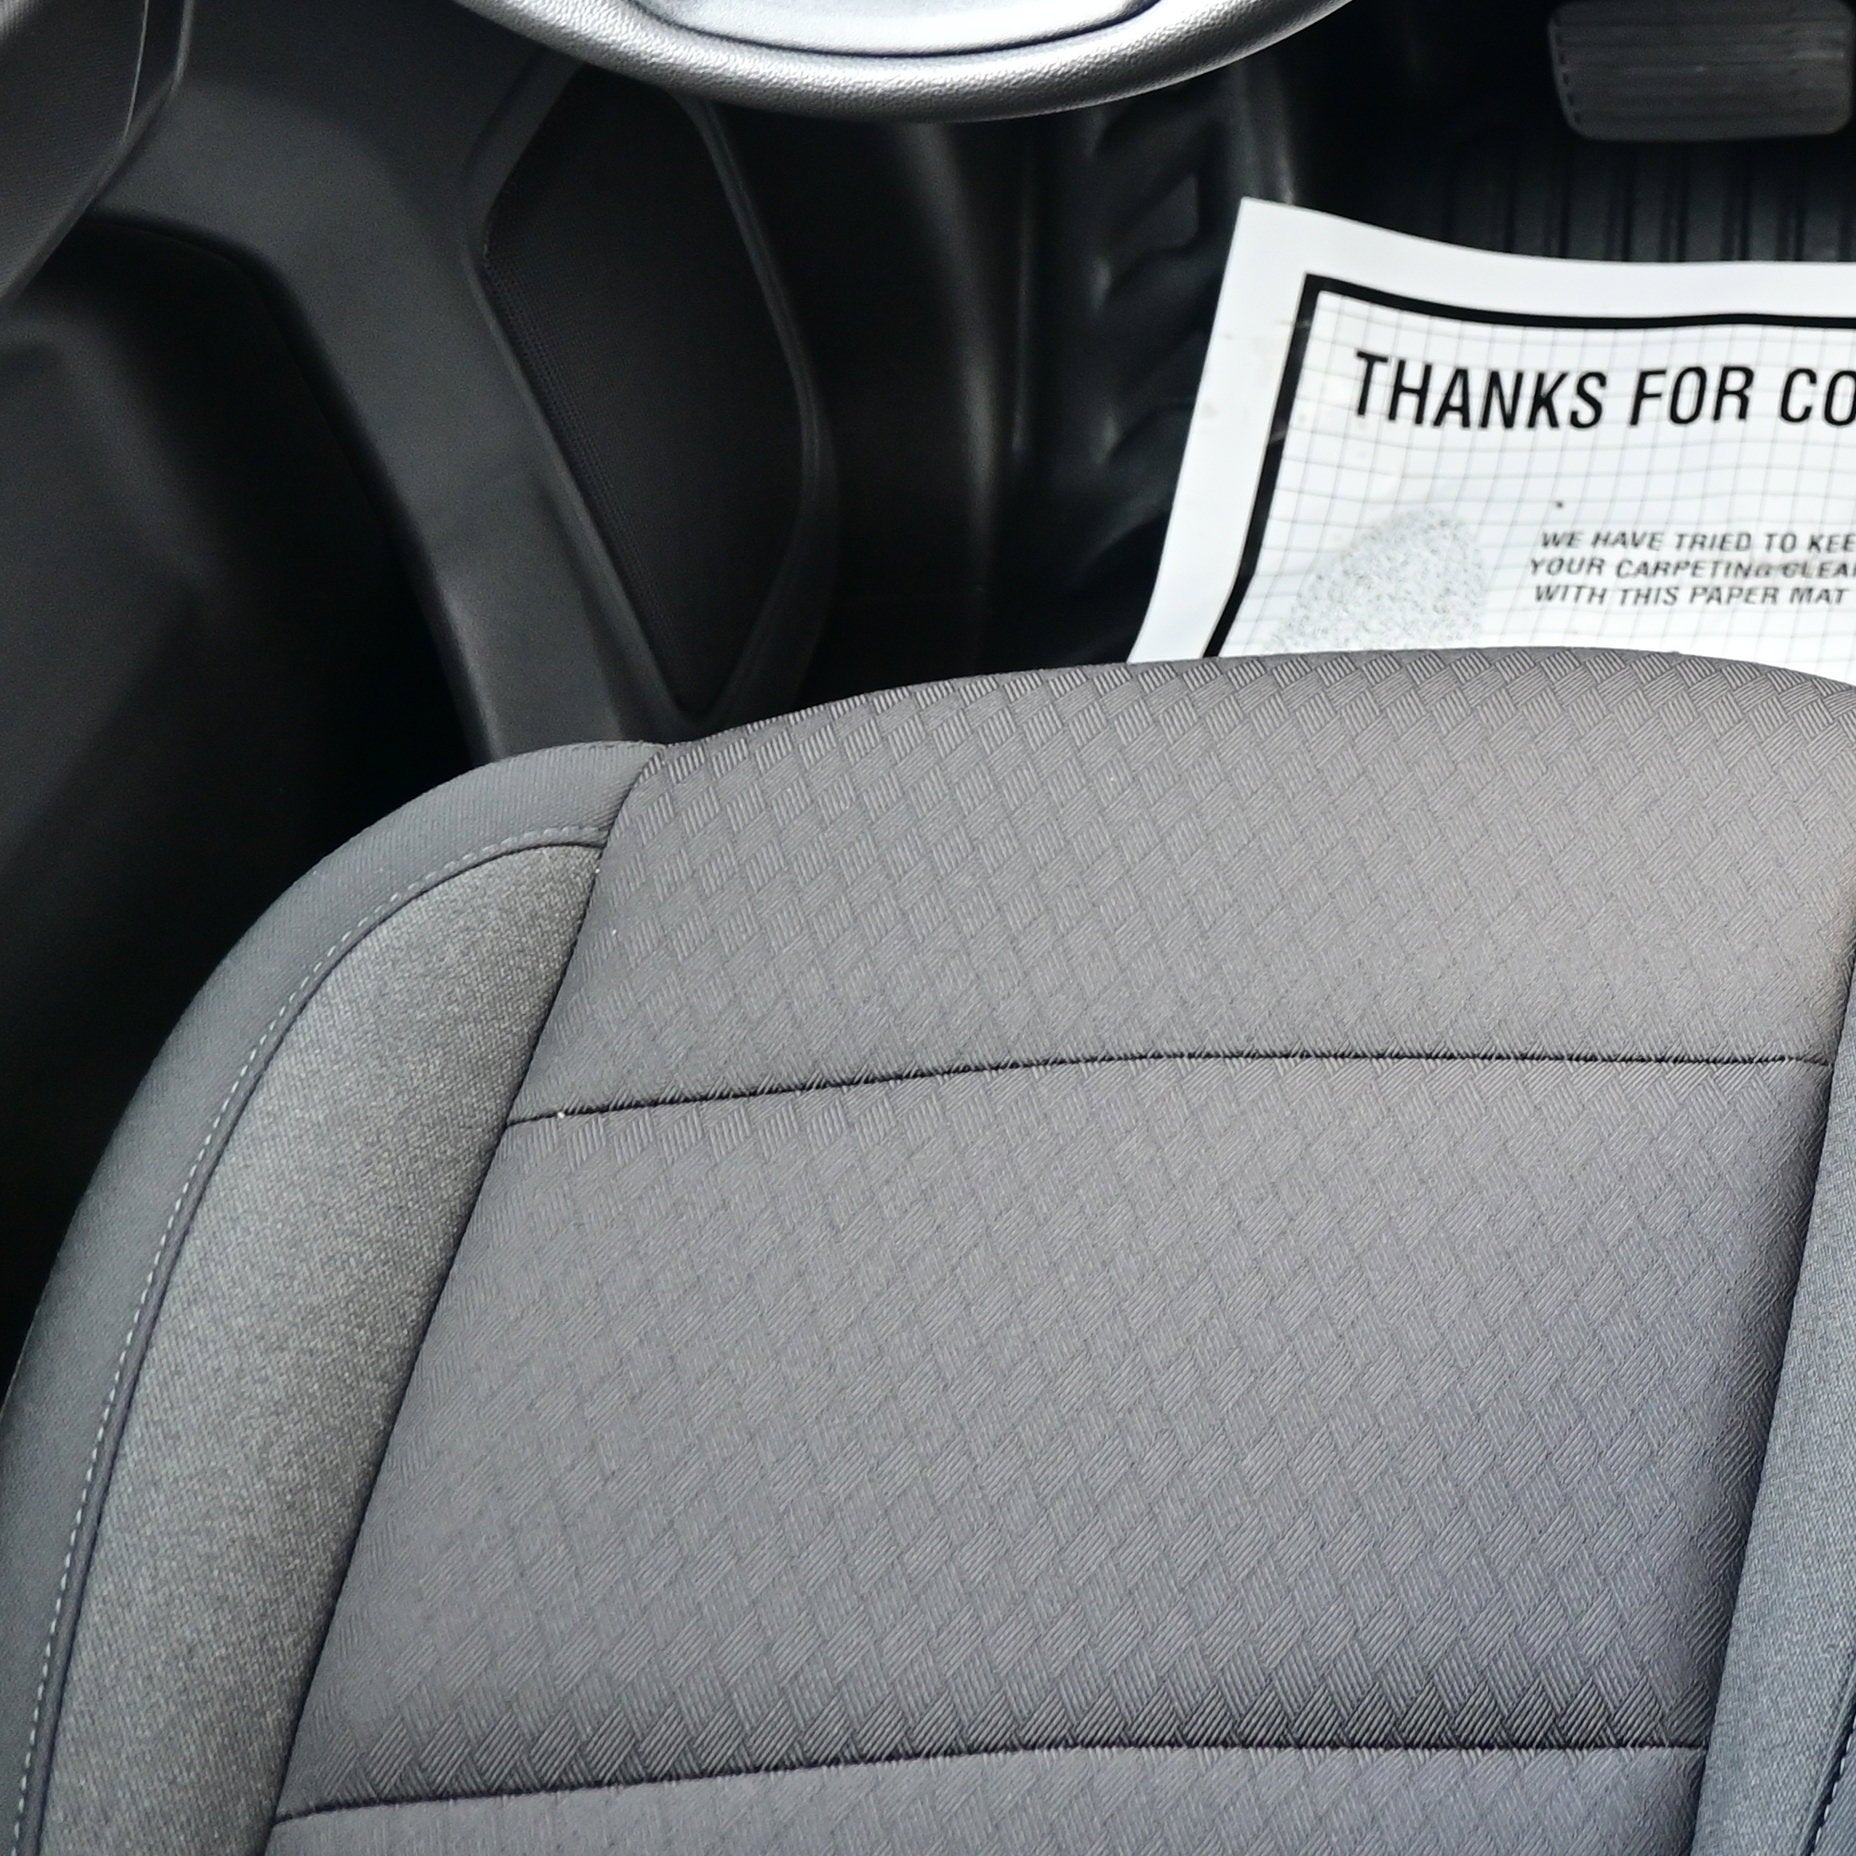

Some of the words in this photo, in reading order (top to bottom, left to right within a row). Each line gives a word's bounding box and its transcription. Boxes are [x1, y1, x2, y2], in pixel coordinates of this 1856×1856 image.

[1356, 350, 1607, 430] THANKS
[1629, 364, 1755, 427] FOR
[1540, 531, 1583, 551] WE
[1591, 531, 1664, 552] HAVE
[1674, 531, 1752, 553] TRIED
[1764, 532, 1797, 554] TO
[1530, 557, 1605, 577] YOUR
[1615, 558, 1774, 580] CARPETING
[1534, 584, 1606, 606] WITH
[1619, 585, 1680, 607] THIS
[1689, 585, 1780, 606] PAPER
[1788, 586, 1850, 606] MAT
